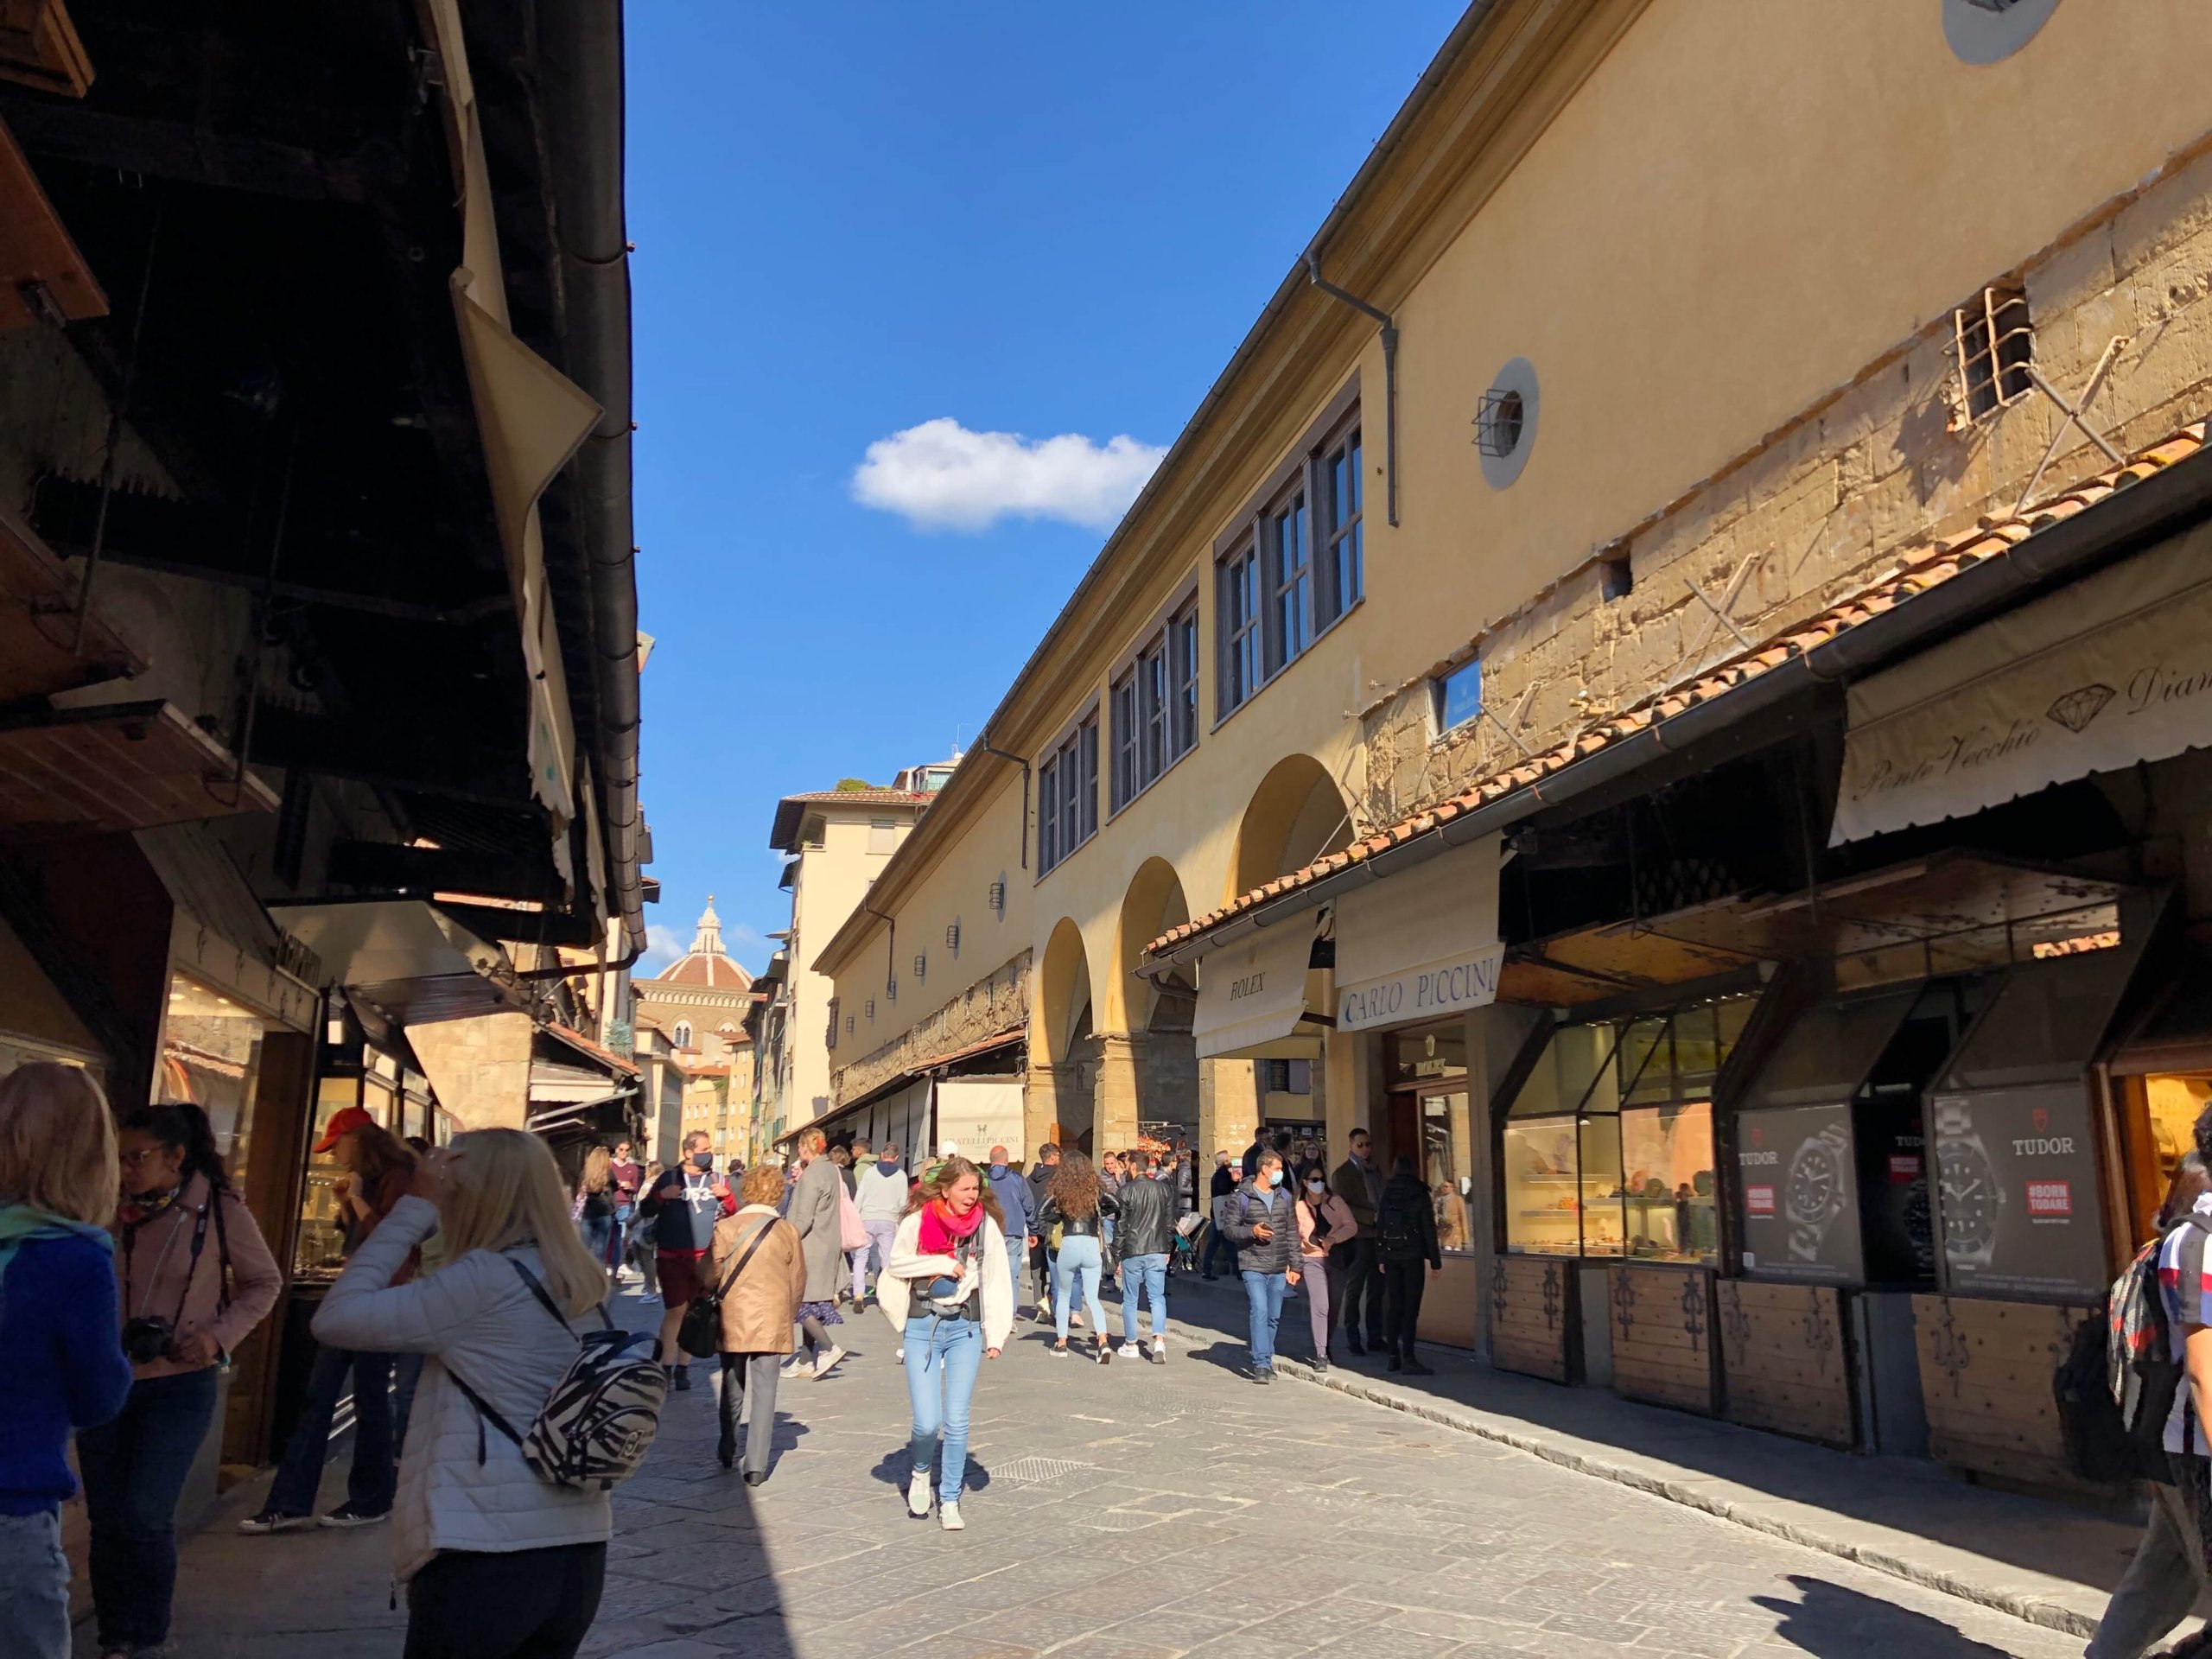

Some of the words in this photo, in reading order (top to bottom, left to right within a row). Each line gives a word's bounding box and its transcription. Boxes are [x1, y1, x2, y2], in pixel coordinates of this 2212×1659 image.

[1852, 759, 1935, 802] Ponte
[1936, 718, 2040, 775] Vecchio
[1230, 971, 1266, 1001] ROLEX
[1344, 982, 1403, 1024] CARLO
[1416, 957, 1495, 1008] PICCINI
[1738, 1151, 1779, 1166] TUDOR
[2012, 1137, 2075, 1155] TUDOR
